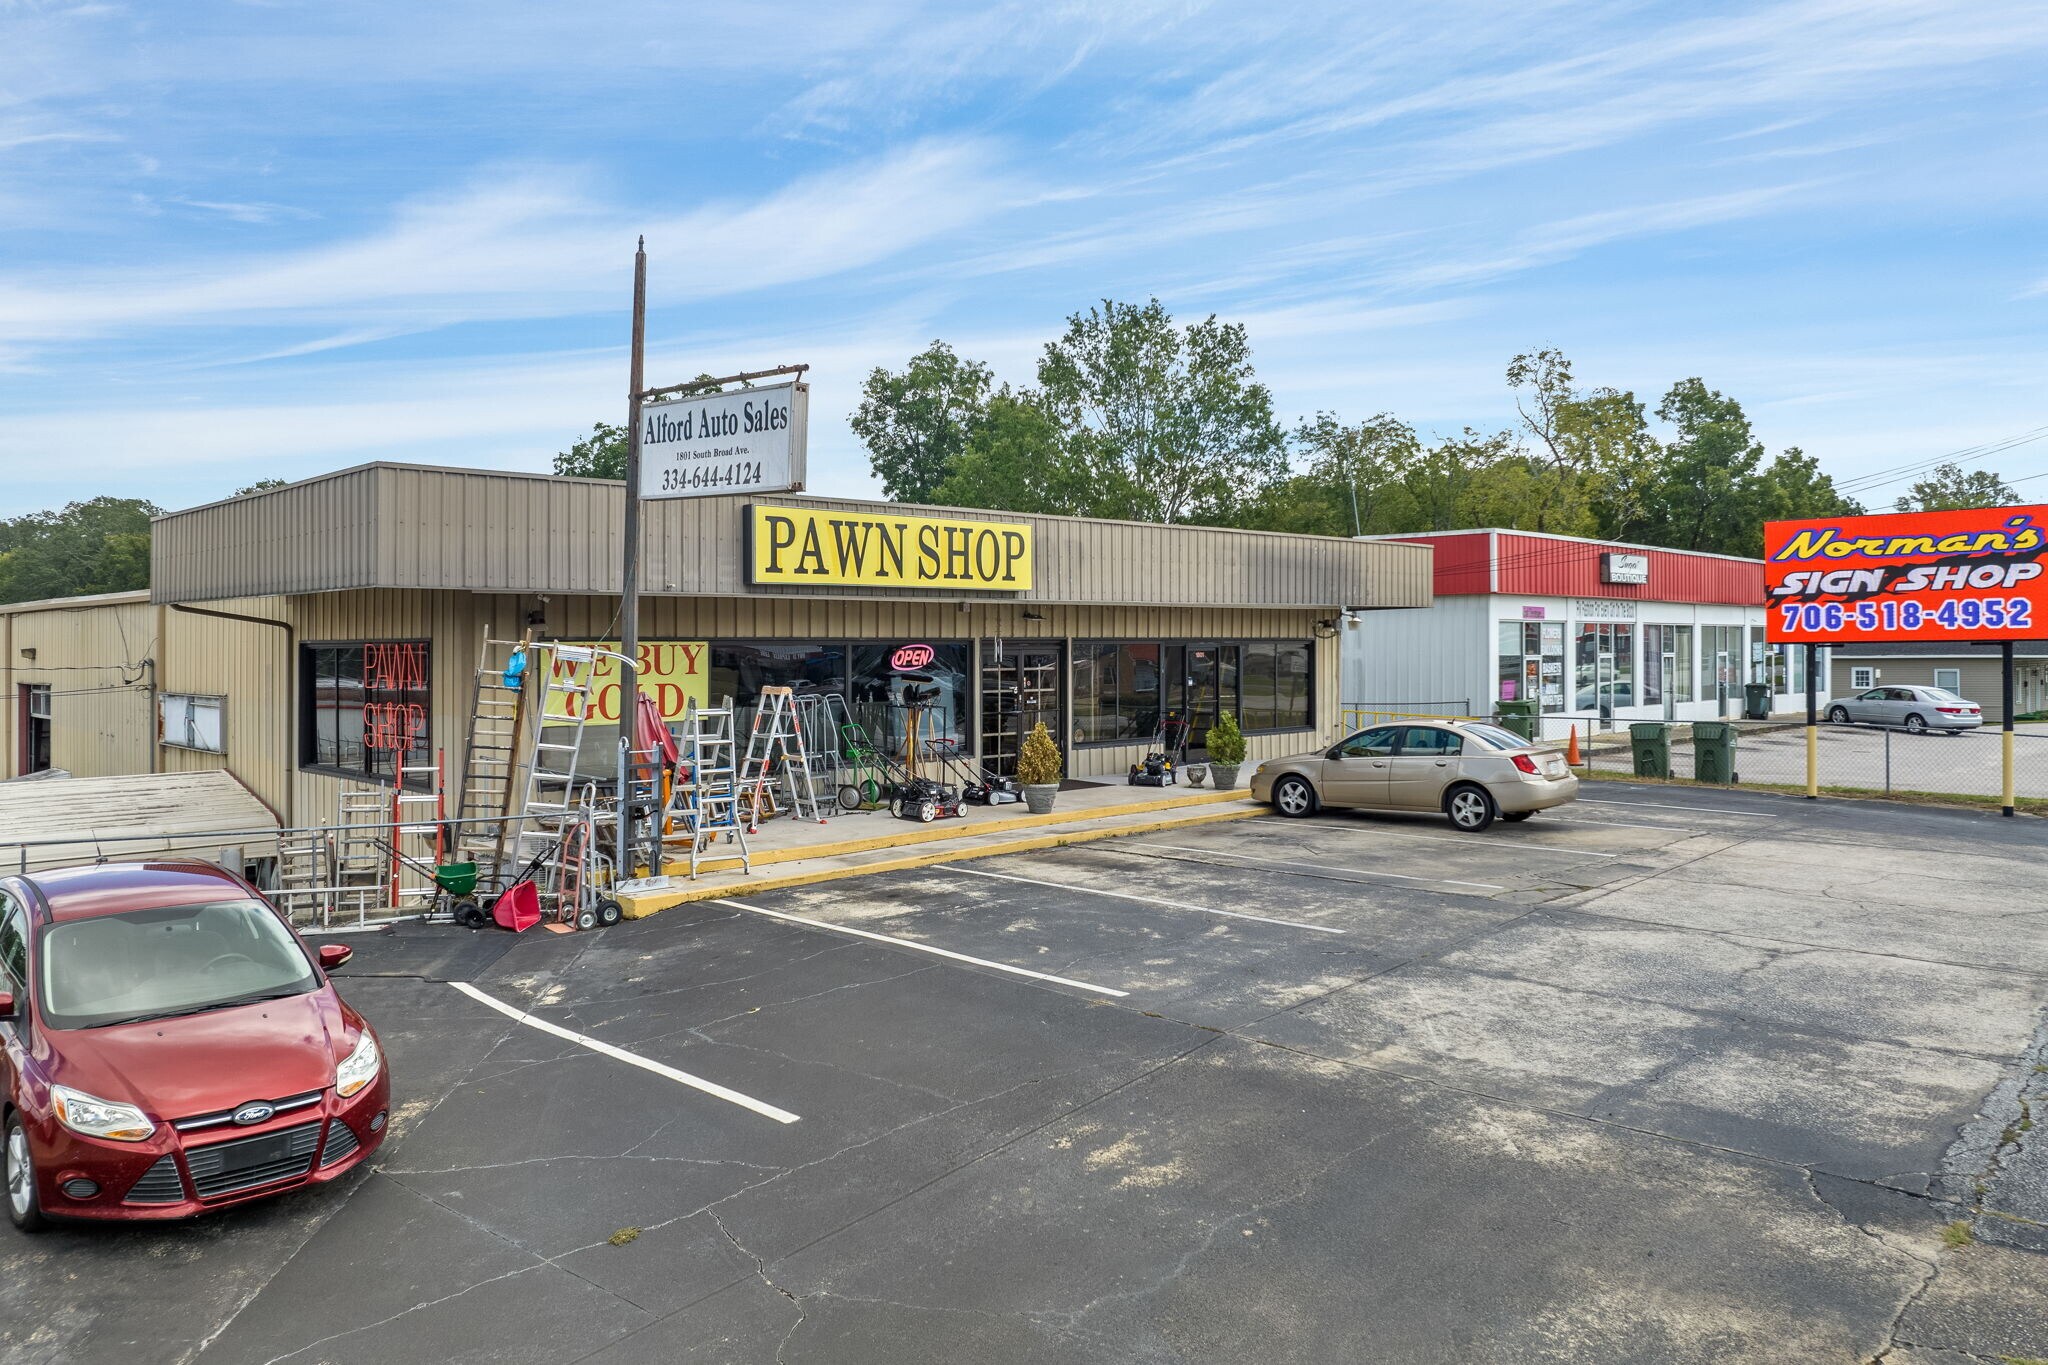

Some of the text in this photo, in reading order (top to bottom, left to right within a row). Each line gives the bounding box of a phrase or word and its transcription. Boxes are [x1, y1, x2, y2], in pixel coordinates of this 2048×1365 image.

[644, 400, 788, 445] Alford Auto Sales
[676, 446, 750, 461] 1801 South Broad Ave.
[662, 461, 762, 491] 334-644-4124
[765, 515, 1026, 582] PAWN SHOP
[1772, 516, 2042, 562] Norman's
[1611, 573, 1647, 583] BOUTIQUE
[1773, 562, 2043, 596] SIGN SHOP
[1782, 597, 2032, 632] 706-518-4952
[363, 643, 424, 691] PAWN
[895, 650, 929, 666] OPEN
[1542, 662, 1562, 674] BASKETS
[565, 683, 685, 721] GOD
[363, 702, 424, 752] SHOP
